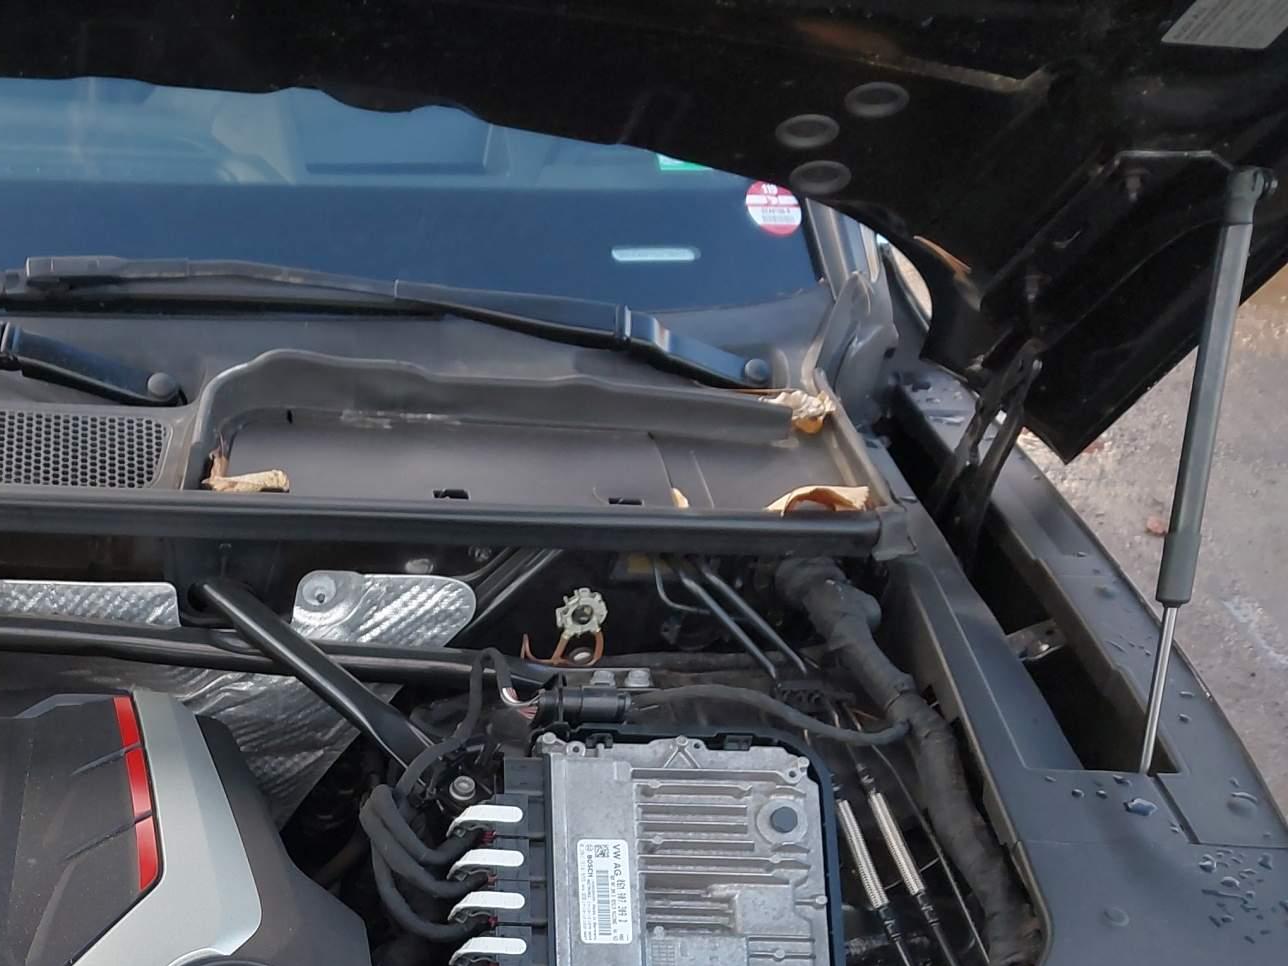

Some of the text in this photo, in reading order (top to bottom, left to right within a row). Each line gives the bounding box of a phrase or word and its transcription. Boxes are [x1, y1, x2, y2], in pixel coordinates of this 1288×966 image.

[612, 844, 621, 860] VW
[586, 855, 594, 878] BOSCH
[613, 863, 622, 877] AG
